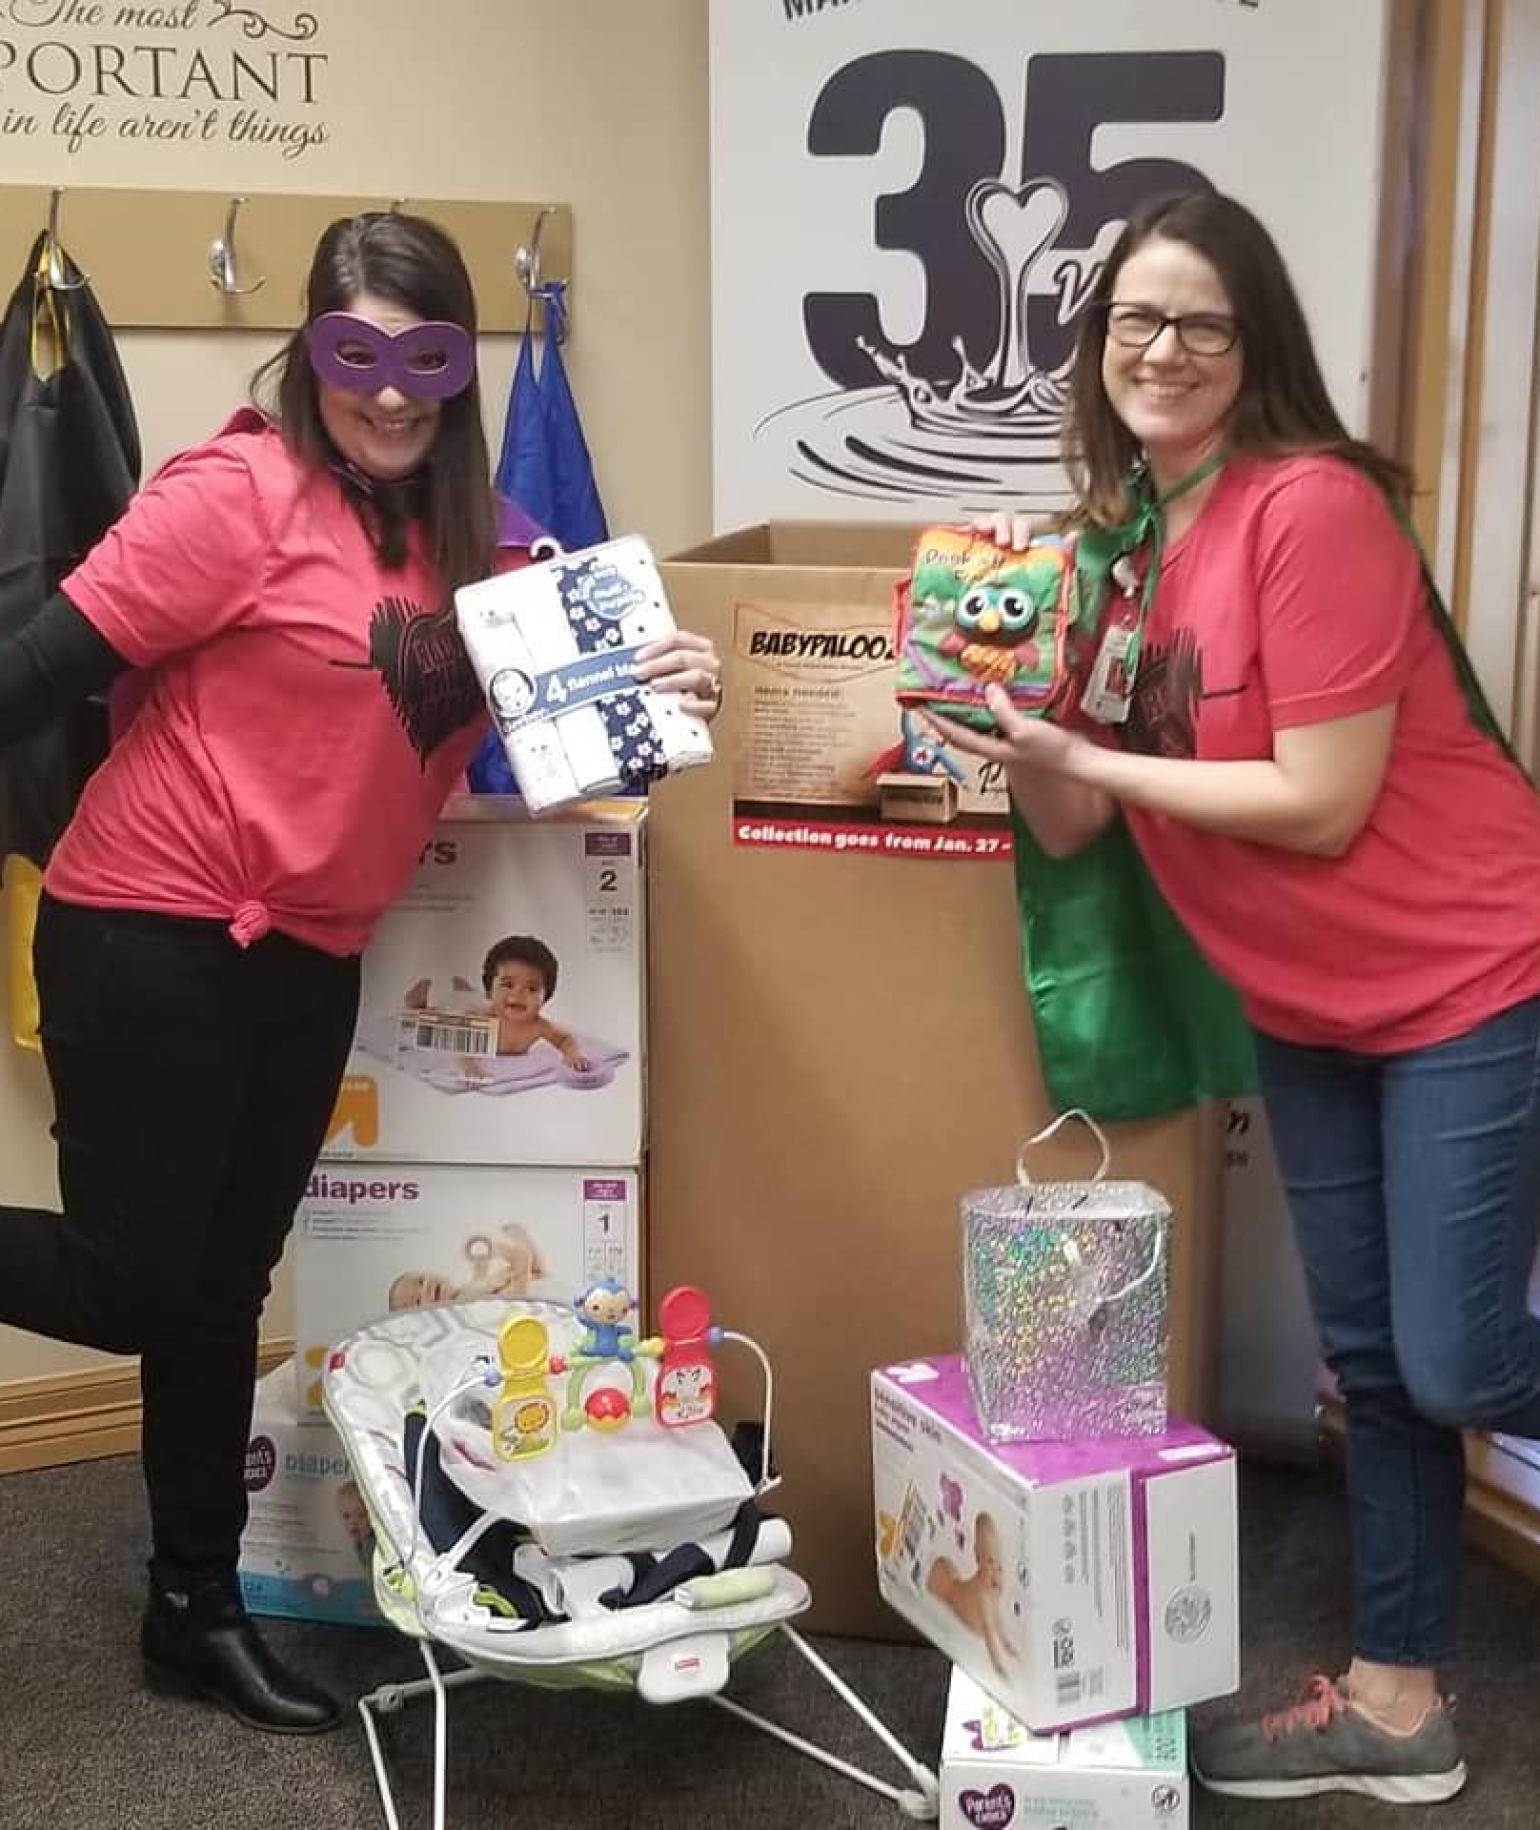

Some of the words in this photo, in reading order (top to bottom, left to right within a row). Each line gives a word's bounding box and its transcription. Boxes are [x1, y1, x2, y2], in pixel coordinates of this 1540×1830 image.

[114, 0, 199, 30] most
[2, 108, 38, 136] in
[51, 103, 106, 154] life
[118, 108, 219, 141] aren't
[228, 110, 329, 159] things
[803, 49, 1226, 391] 35
[750, 630, 895, 660] BABYPALOO
[546, 674, 567, 702] 4
[738, 825, 832, 846] Collection
[834, 833, 879, 849] goes
[885, 832, 931, 850] from
[933, 836, 973, 853] Jan.
[975, 838, 1000, 853] 27
[600, 870, 618, 891] 2
[302, 1173, 420, 1205] diapers
[598, 1213, 609, 1234] 1
